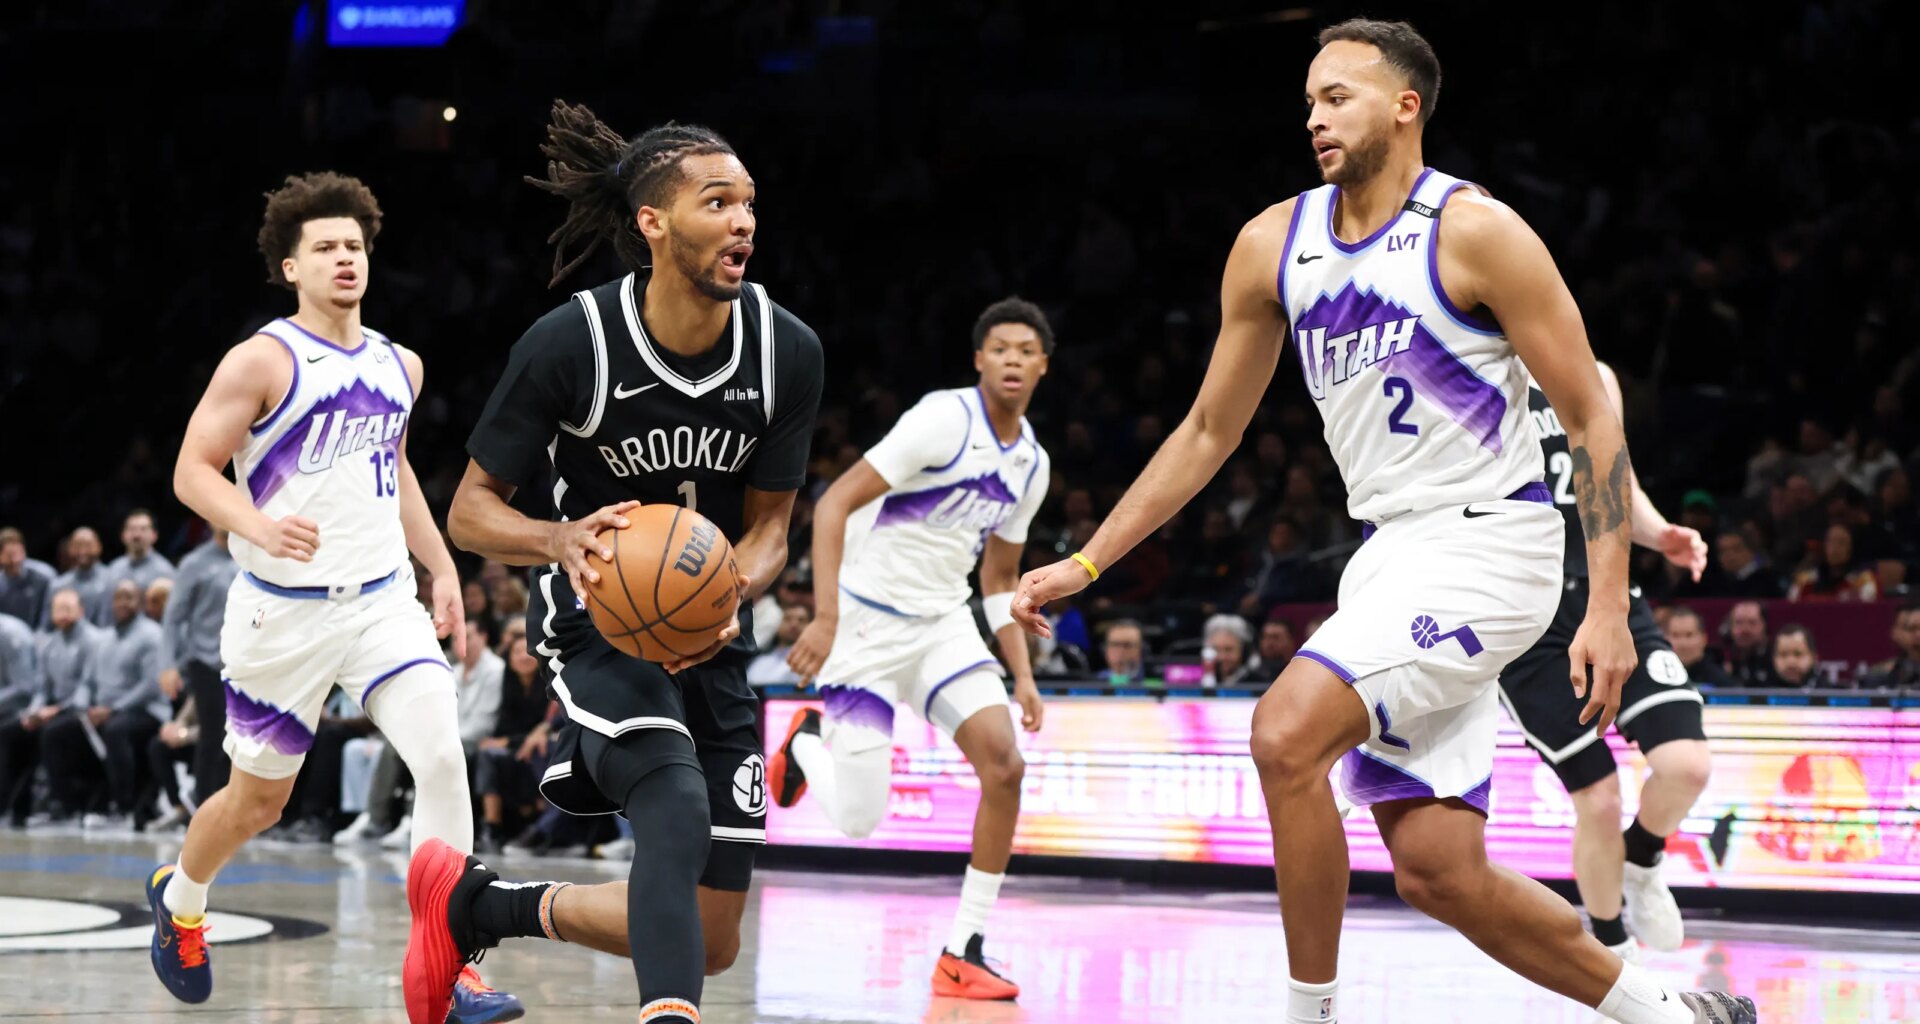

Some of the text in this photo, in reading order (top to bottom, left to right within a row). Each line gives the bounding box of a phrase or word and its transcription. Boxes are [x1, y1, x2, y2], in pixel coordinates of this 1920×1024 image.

[1411, 202, 1434, 217] FRANK
[1387, 233, 1421, 253] LVT
[1297, 314, 1423, 401] UTAH
[723, 388, 735, 402] All
[736, 388, 746, 401] In
[1383, 376, 1419, 437] 2
[297, 409, 408, 475] UTAH
[598, 426, 757, 477] BROOKLY
[369, 451, 396, 498] 13
[1550, 451, 1577, 504] 2
[674, 517, 717, 578] Wils
[1022, 751, 1097, 813] EAL
